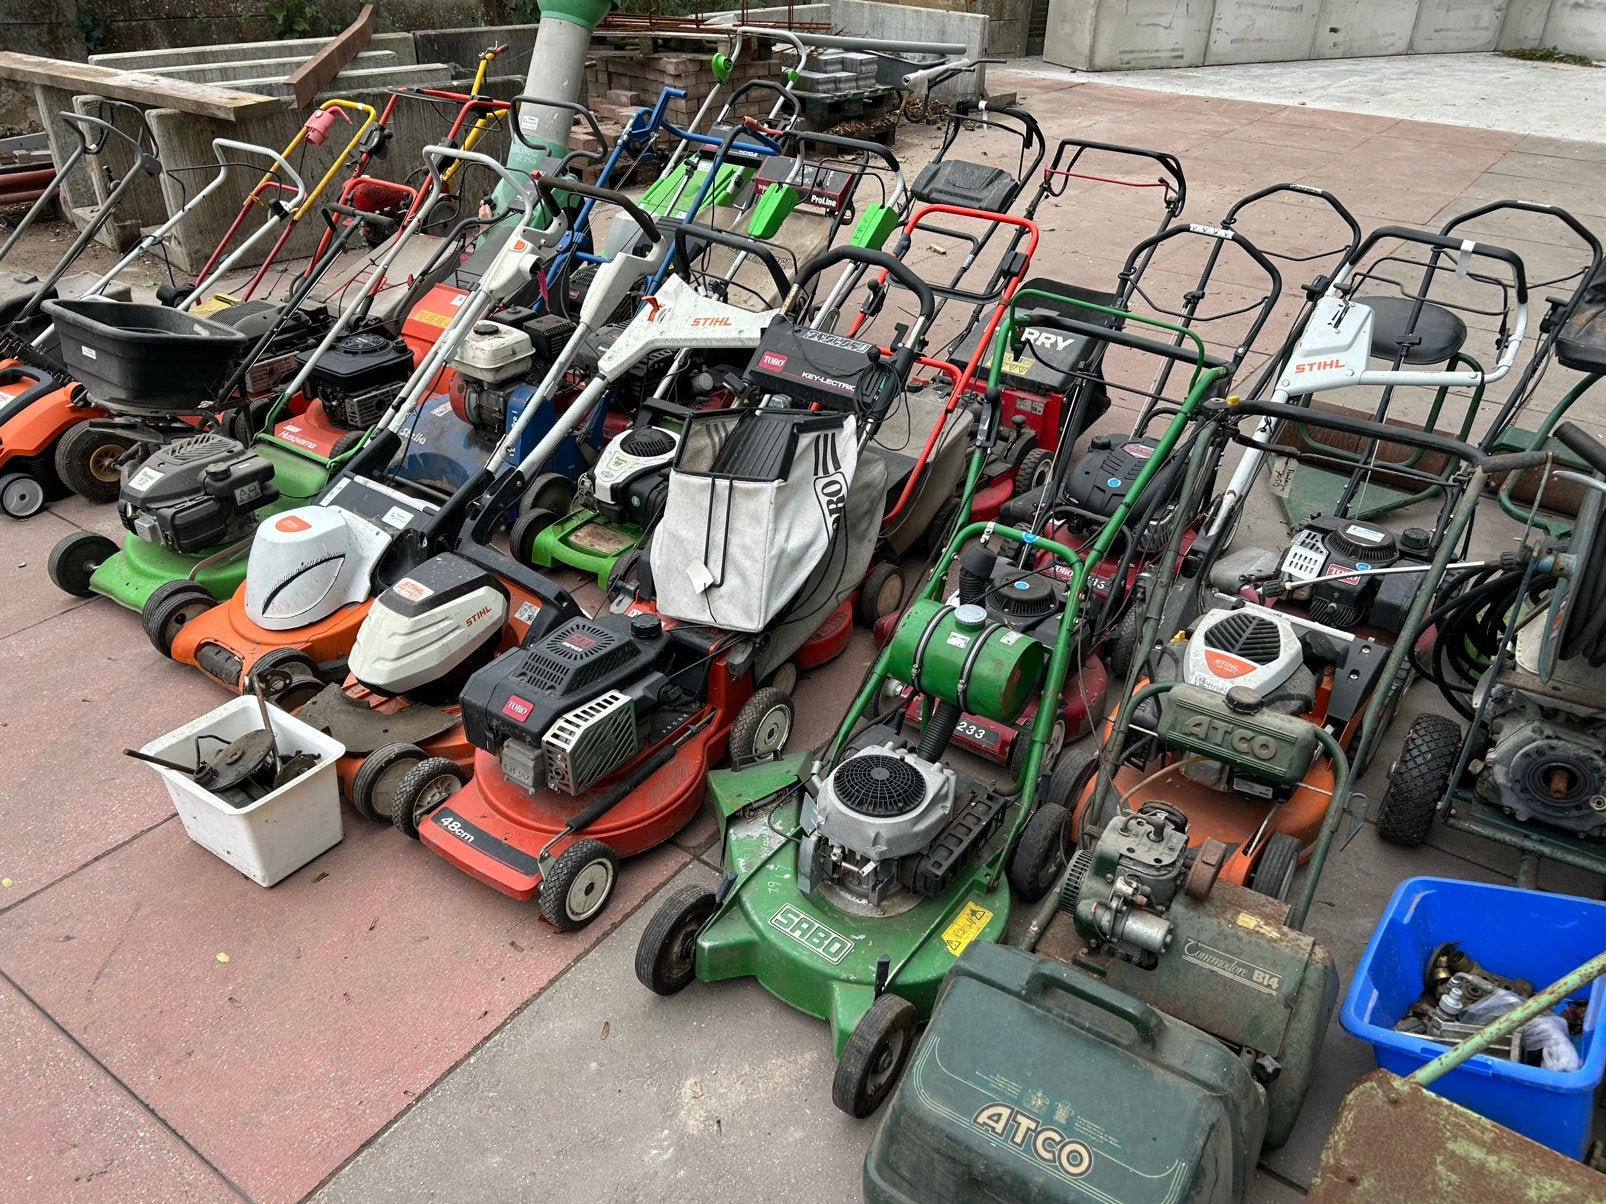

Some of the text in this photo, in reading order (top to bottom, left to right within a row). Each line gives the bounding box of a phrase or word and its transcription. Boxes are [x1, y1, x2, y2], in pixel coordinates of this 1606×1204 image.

[811, 195, 837, 207] ProLine
[690, 317, 732, 327] STIHL
[994, 326, 1076, 351] RRY
[763, 354, 785, 367] TORO
[1294, 359, 1346, 374] STIHL
[801, 371, 856, 392] KEY-LECTRIC
[278, 430, 317, 450] Husqvarna
[465, 605, 492, 627] STIHL
[507, 700, 528, 715] TORO
[956, 721, 986, 739] 233
[1183, 715, 1278, 761] ATCO
[440, 816, 475, 843] 48cm
[774, 904, 853, 964] SABO
[1183, 938, 1280, 990] Commodore B14
[971, 1101, 1094, 1179] ATCO
